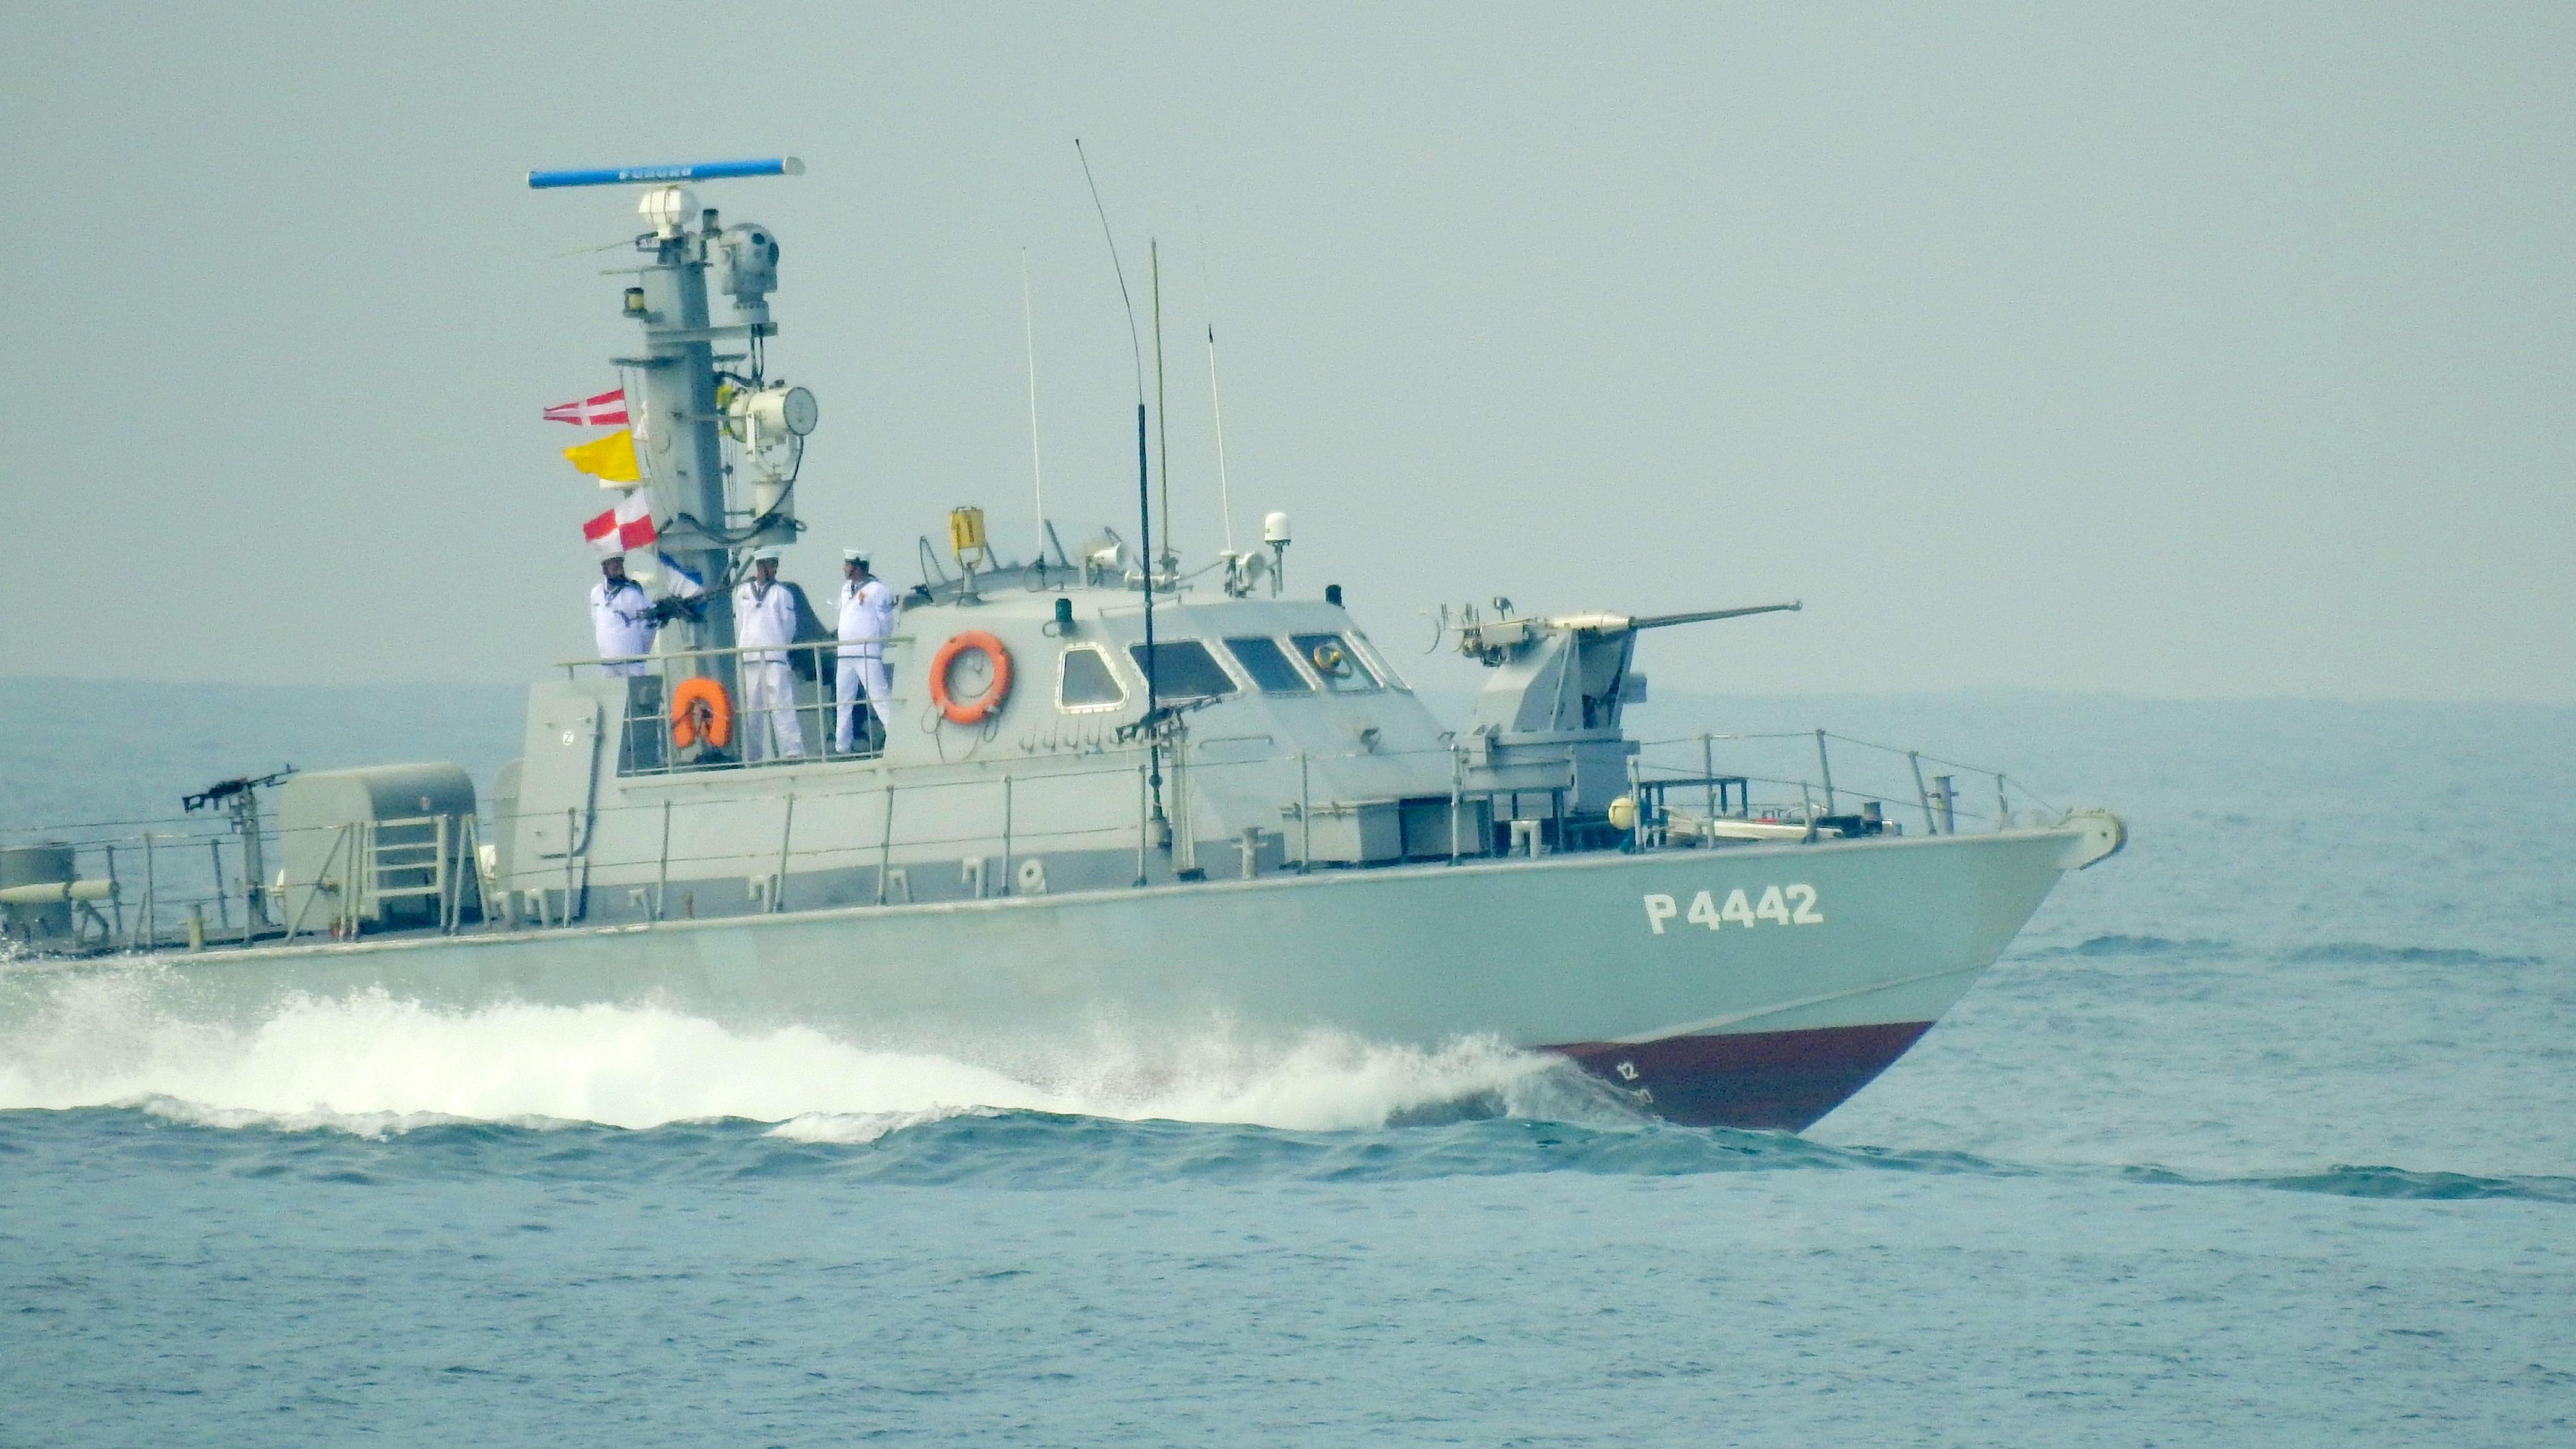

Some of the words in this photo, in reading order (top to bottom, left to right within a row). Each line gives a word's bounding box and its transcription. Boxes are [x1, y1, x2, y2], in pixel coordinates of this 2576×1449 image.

[1644, 894, 1678, 934] P
[1687, 884, 1824, 930] 4442
[1617, 1062, 1639, 1080] 12
